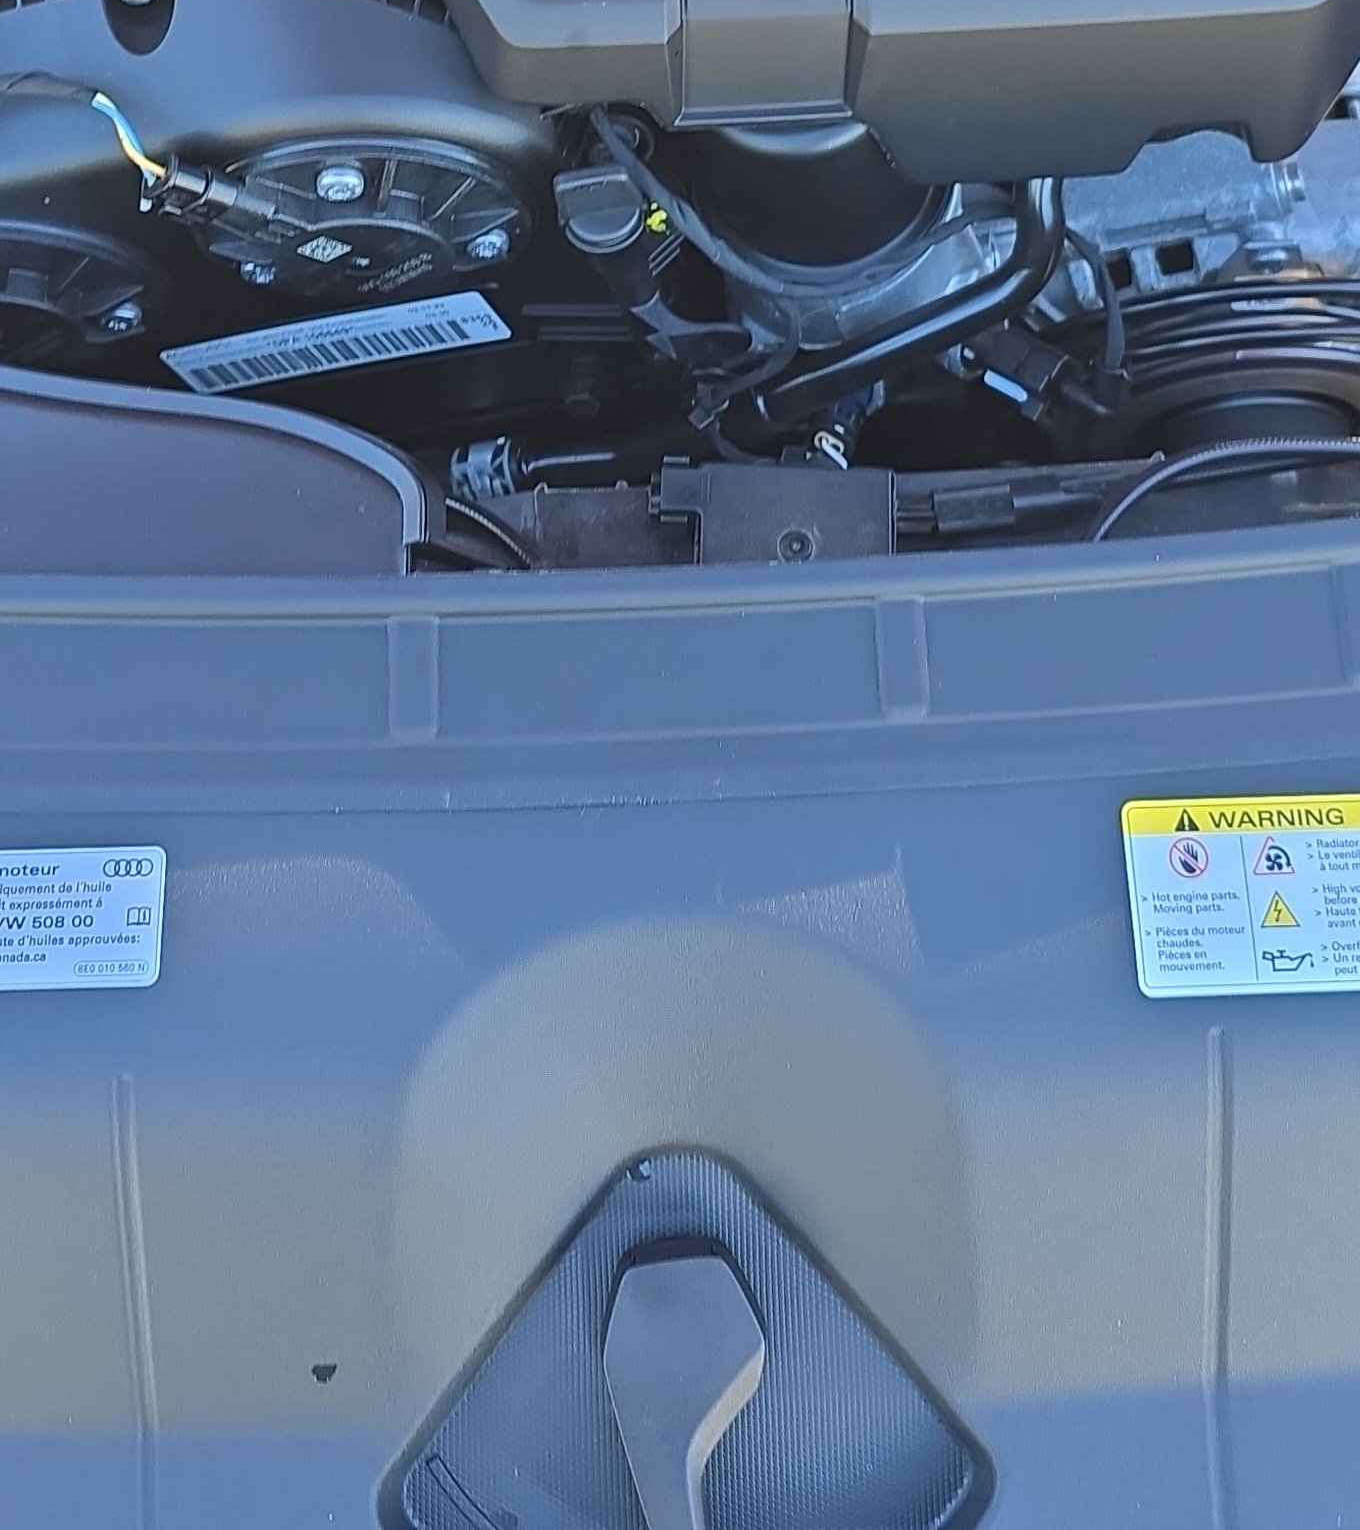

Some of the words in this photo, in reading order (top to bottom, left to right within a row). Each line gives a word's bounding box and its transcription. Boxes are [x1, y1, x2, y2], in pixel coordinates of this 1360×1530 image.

[1208, 807, 1345, 828] WARNING
[1316, 837, 1359, 849] Radiator
[1318, 849, 1330, 860] Le
[1328, 861, 1350, 871] tout
[58, 881, 73, 894] de
[1322, 883, 1347, 895] High
[1152, 891, 1171, 902] Hot
[1173, 891, 1208, 903] engine
[1324, 894, 1358, 905] before
[9, 897, 93, 913] expressément
[1153, 903, 1193, 914] Moving
[1196, 903, 1225, 914] parts.
[1325, 906, 1356, 916] Haute
[32, 915, 65, 929] 508
[71, 914, 94, 928] 00
[1328, 918, 1356, 928] avant
[1156, 926, 1189, 937] Pièces
[1191, 926, 1205, 935] du
[1208, 926, 1245, 935] moteur
[18, 934, 64, 947] d'huiles
[68, 933, 140, 947] approuvées:
[1157, 938, 1203, 948] chaudes.
[1158, 949, 1191, 959] Pièces
[1194, 950, 1207, 959] en
[1333, 952, 1348, 963] Un
[98, 963, 115, 973] 010
[1159, 961, 1225, 972] mouvement.
[1335, 965, 1358, 976] peut
